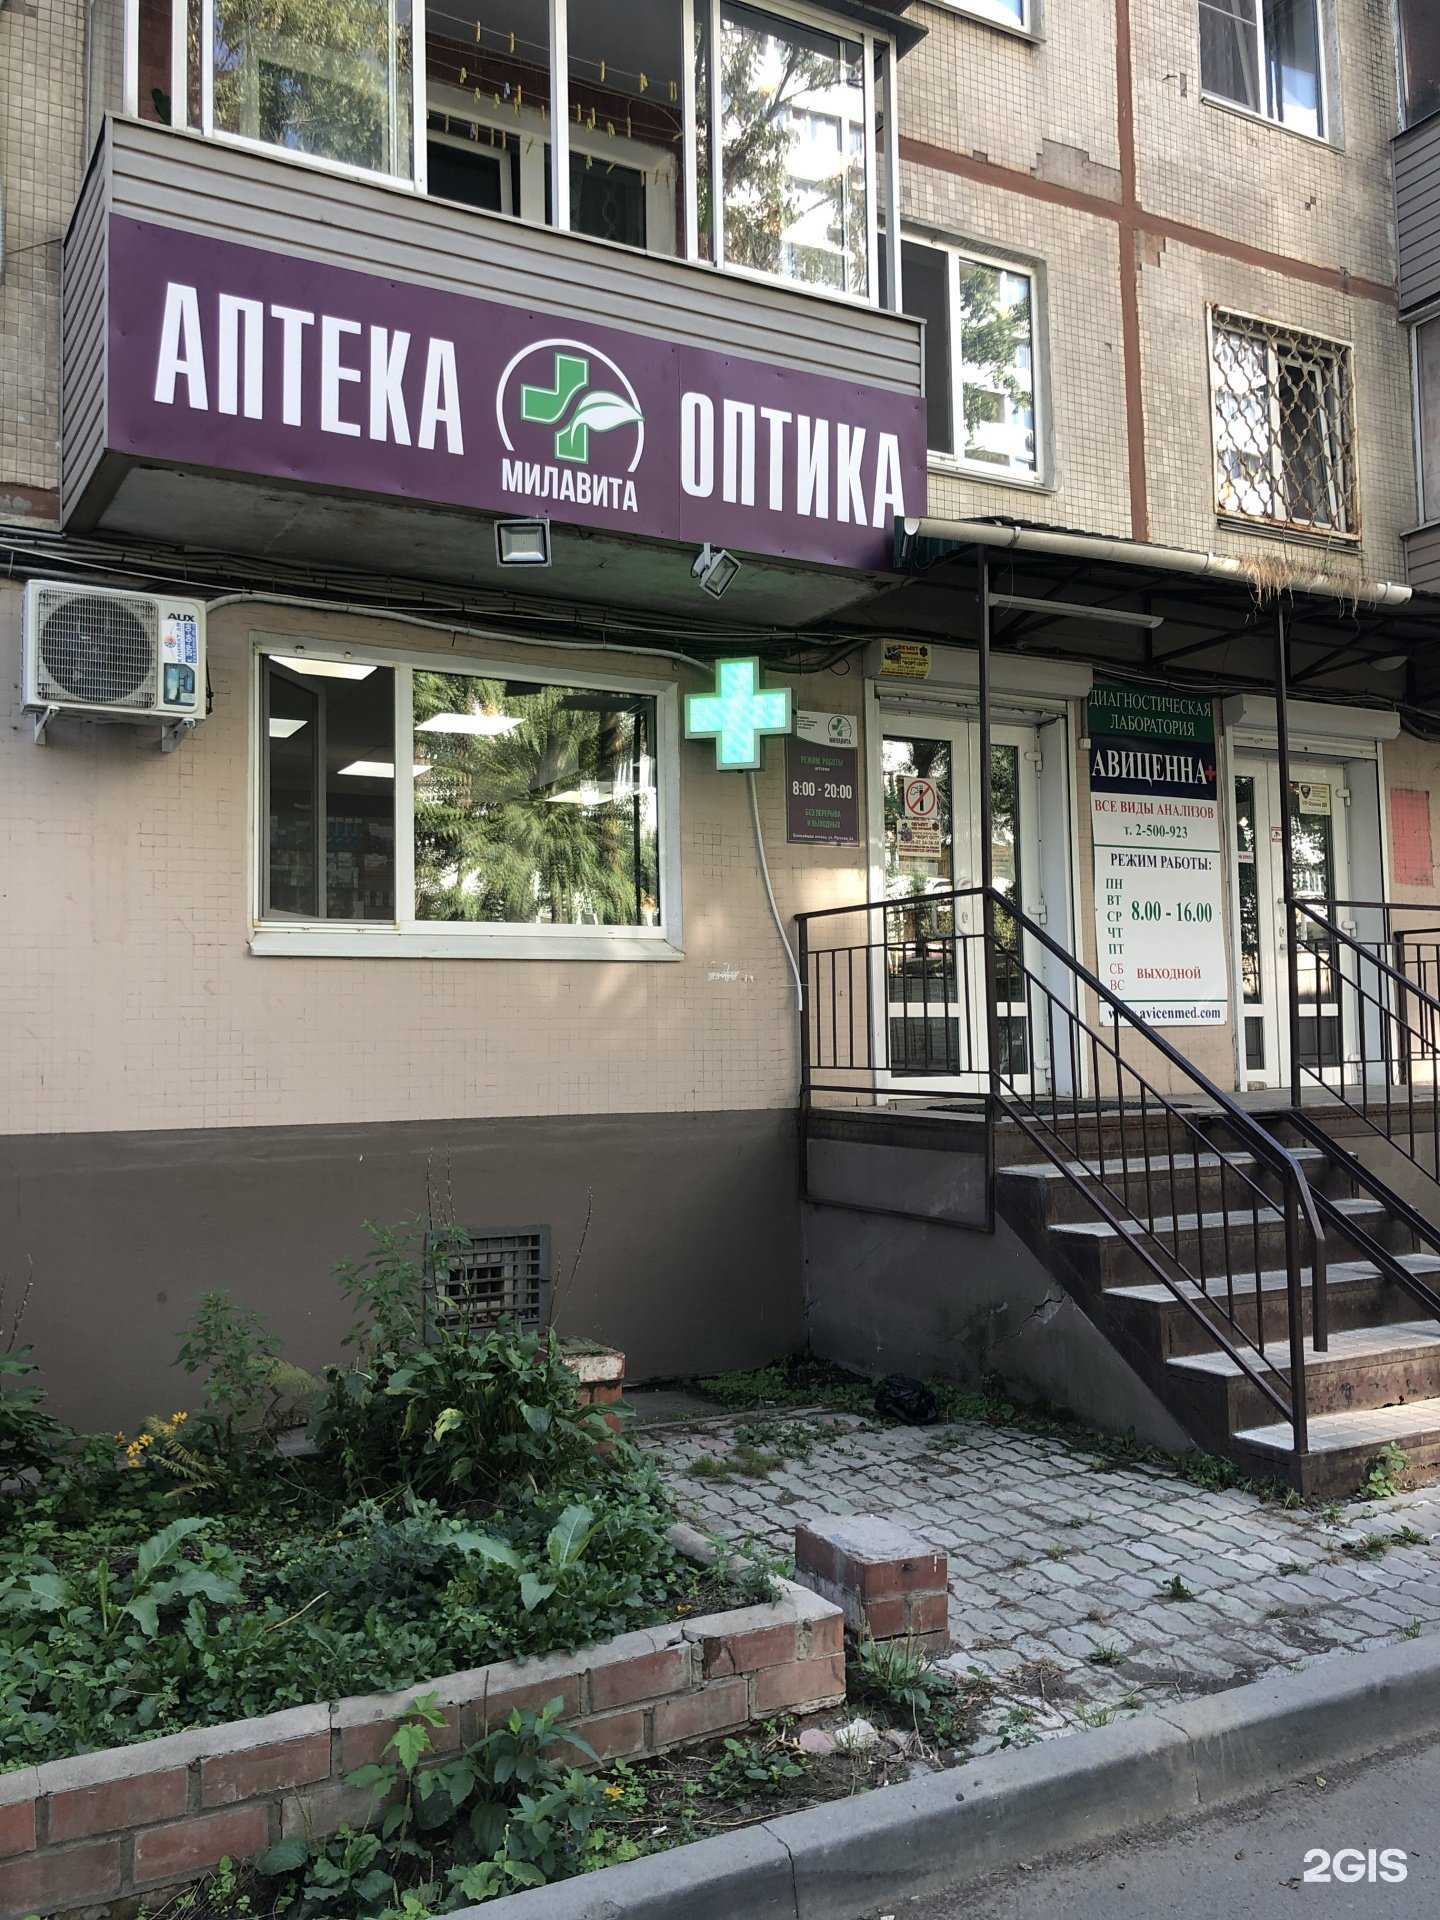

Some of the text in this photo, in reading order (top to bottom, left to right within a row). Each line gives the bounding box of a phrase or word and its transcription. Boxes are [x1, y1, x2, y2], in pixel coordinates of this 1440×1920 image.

[153, 281, 464, 456] АПТЕКА
[679, 390, 905, 529] ОПТИКА
[500, 457, 638, 513] МИЛАВИТА
[168, 613, 195, 622] AUX
[1089, 689, 1212, 717] ДИАГНОСТИЧЕСКАЯ
[1110, 714, 1195, 737] ЛАБОРАТОРИЯ
[1091, 749, 1208, 788] АВИЦЕННА
[792, 781, 815, 797] 8:00
[824, 783, 852, 800] 20:00
[1094, 799, 1215, 819] ВСЕ ВИДЫ АНАЛИЗОВ
[1124, 823, 1188, 839] т. 2-500-923
[1110, 853, 1212, 871] РЕЖИМ РАБОТЫ:
[1105, 878, 1123, 890] ПН
[1107, 894, 1122, 906] ВТ
[1107, 911, 1122, 922] СР
[1131, 900, 1162, 922] 8.00
[1176, 902, 1213, 923] 16.00
[1107, 927, 1124, 939] ЧТ
[1108, 943, 1125, 955] ПТ
[1109, 962, 1124, 975] СБ
[1137, 966, 1202, 981] ВЫХОДНОЙ
[1110, 979, 1125, 991] ВС
